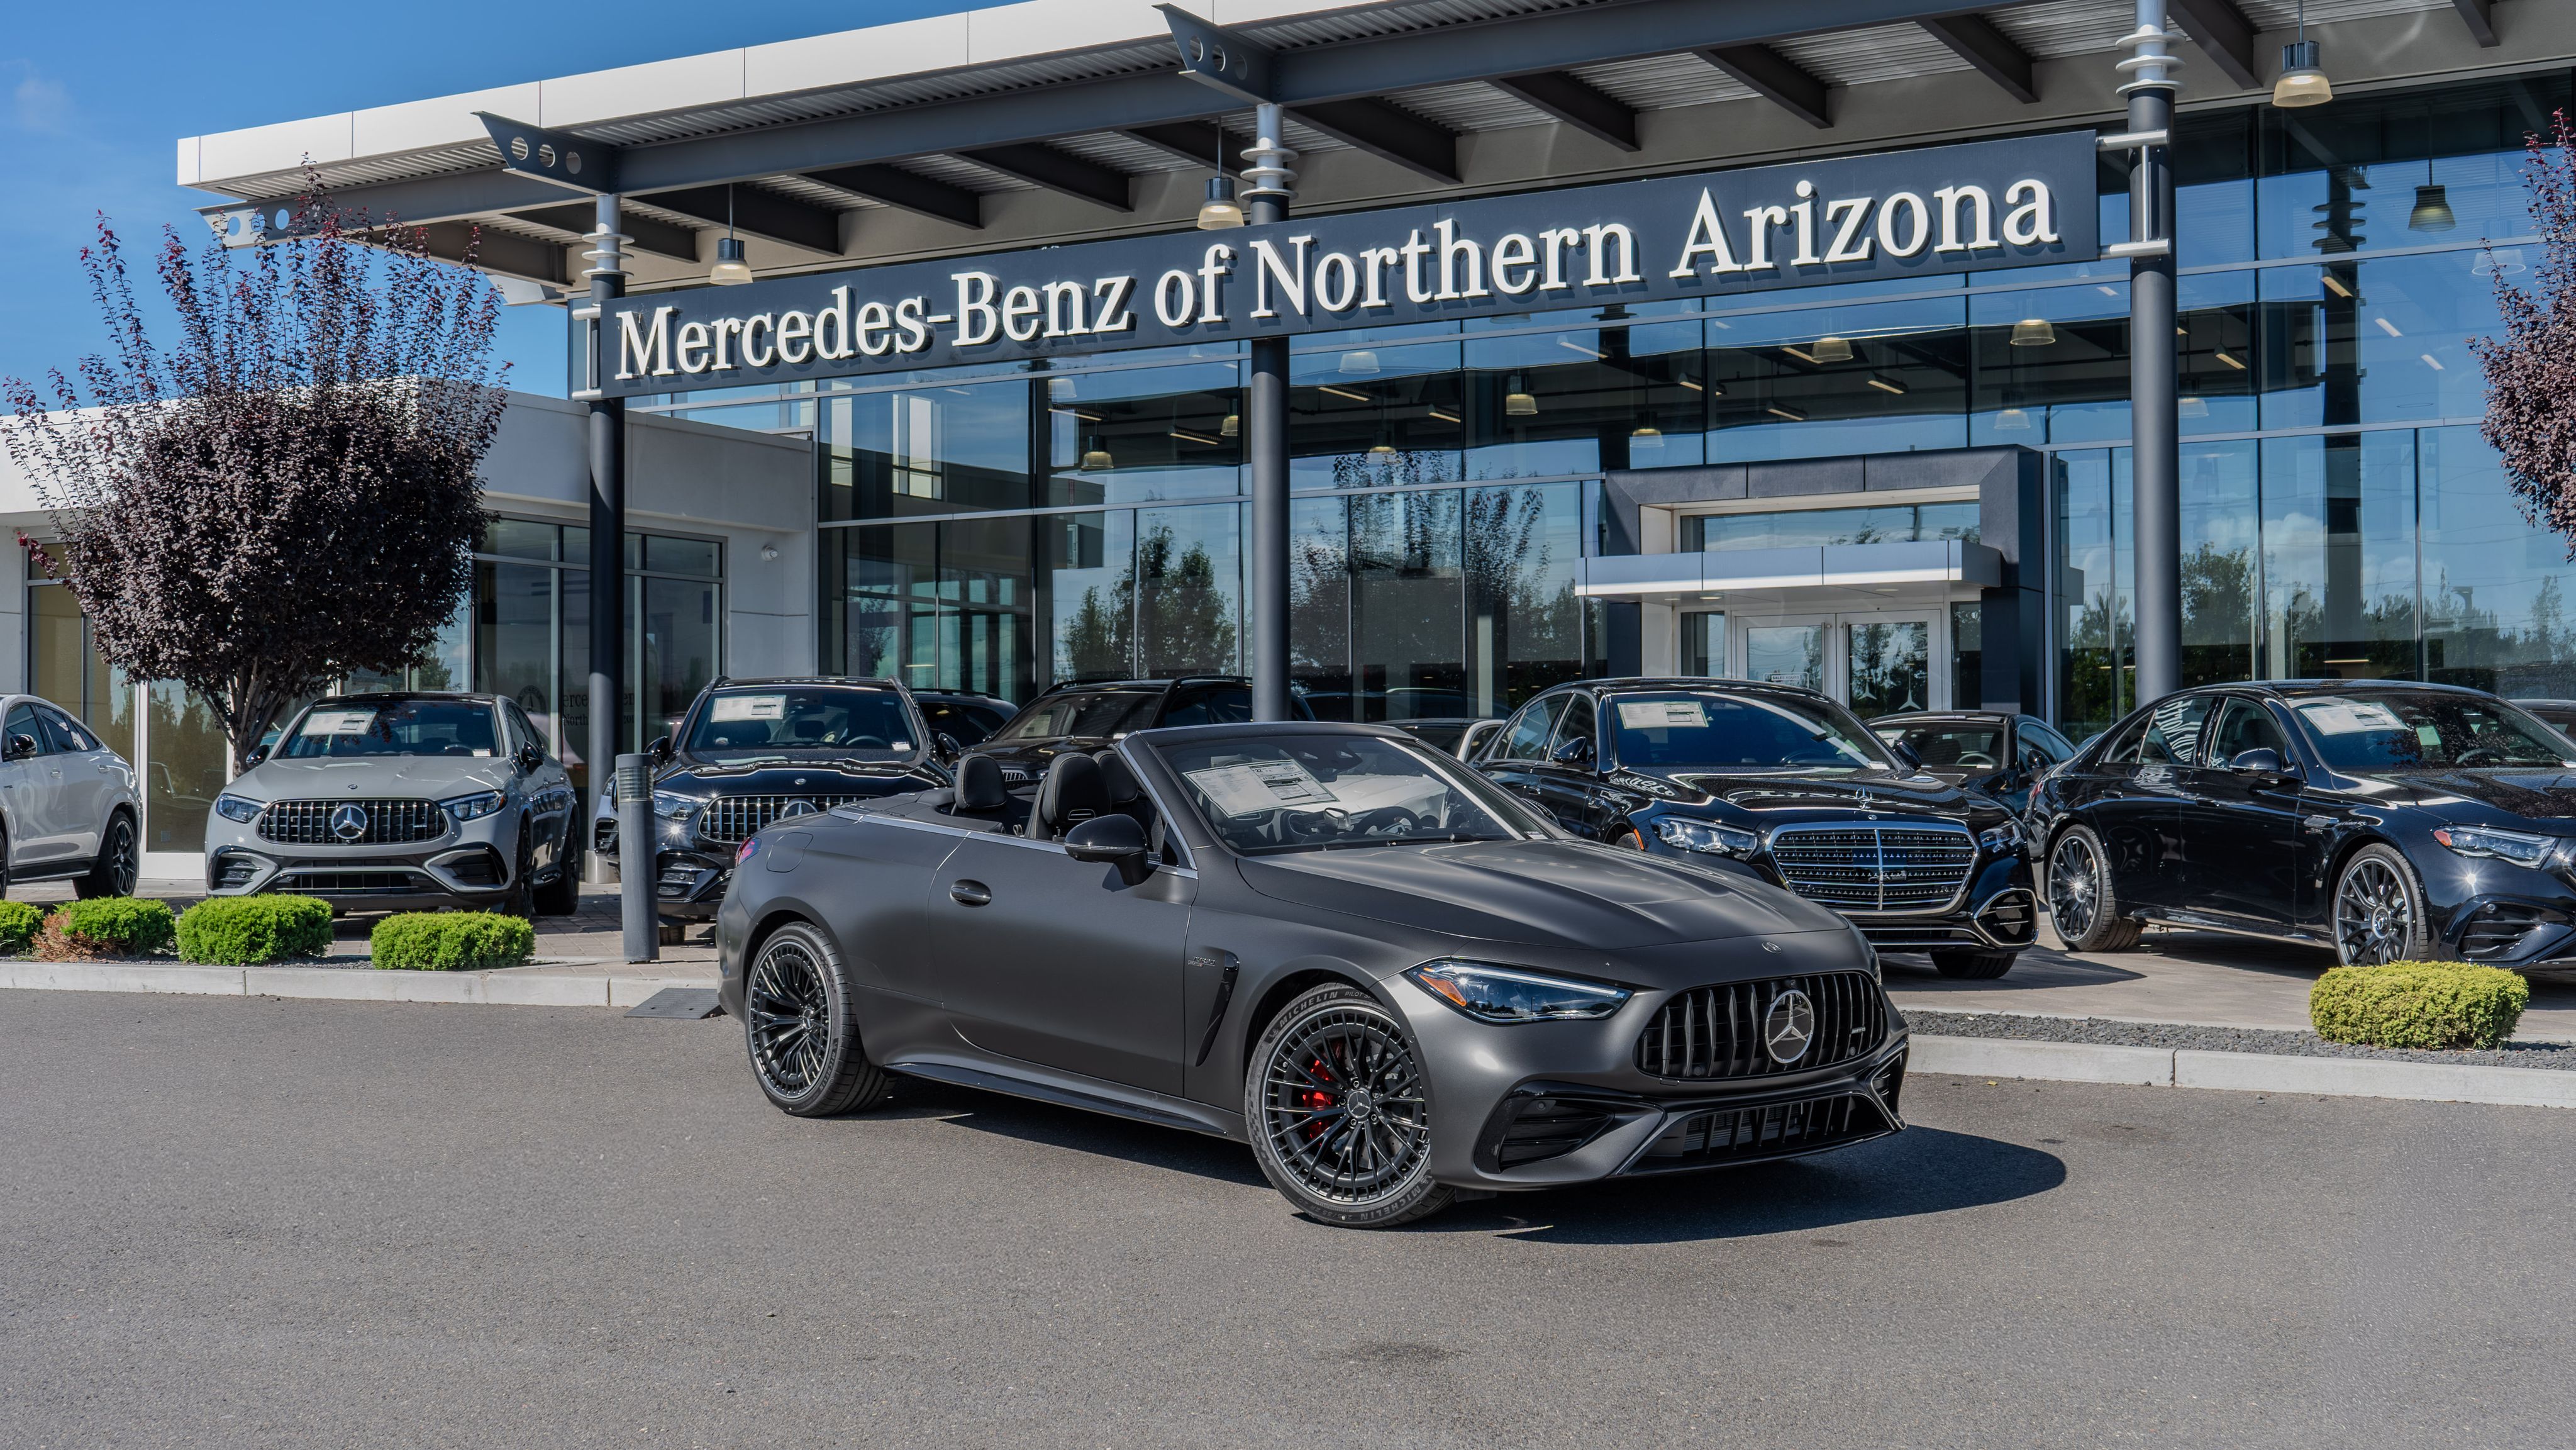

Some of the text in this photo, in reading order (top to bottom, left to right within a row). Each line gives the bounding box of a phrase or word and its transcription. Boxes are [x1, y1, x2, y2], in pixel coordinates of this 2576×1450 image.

[614, 179, 2060, 381] Mercedes-Benz of Northern Arizona
[1279, 991, 1339, 1029] MICHELIN
[819, 1052, 836, 1091] MICHELIN
[1359, 1184, 1421, 1221] MICHELIN
